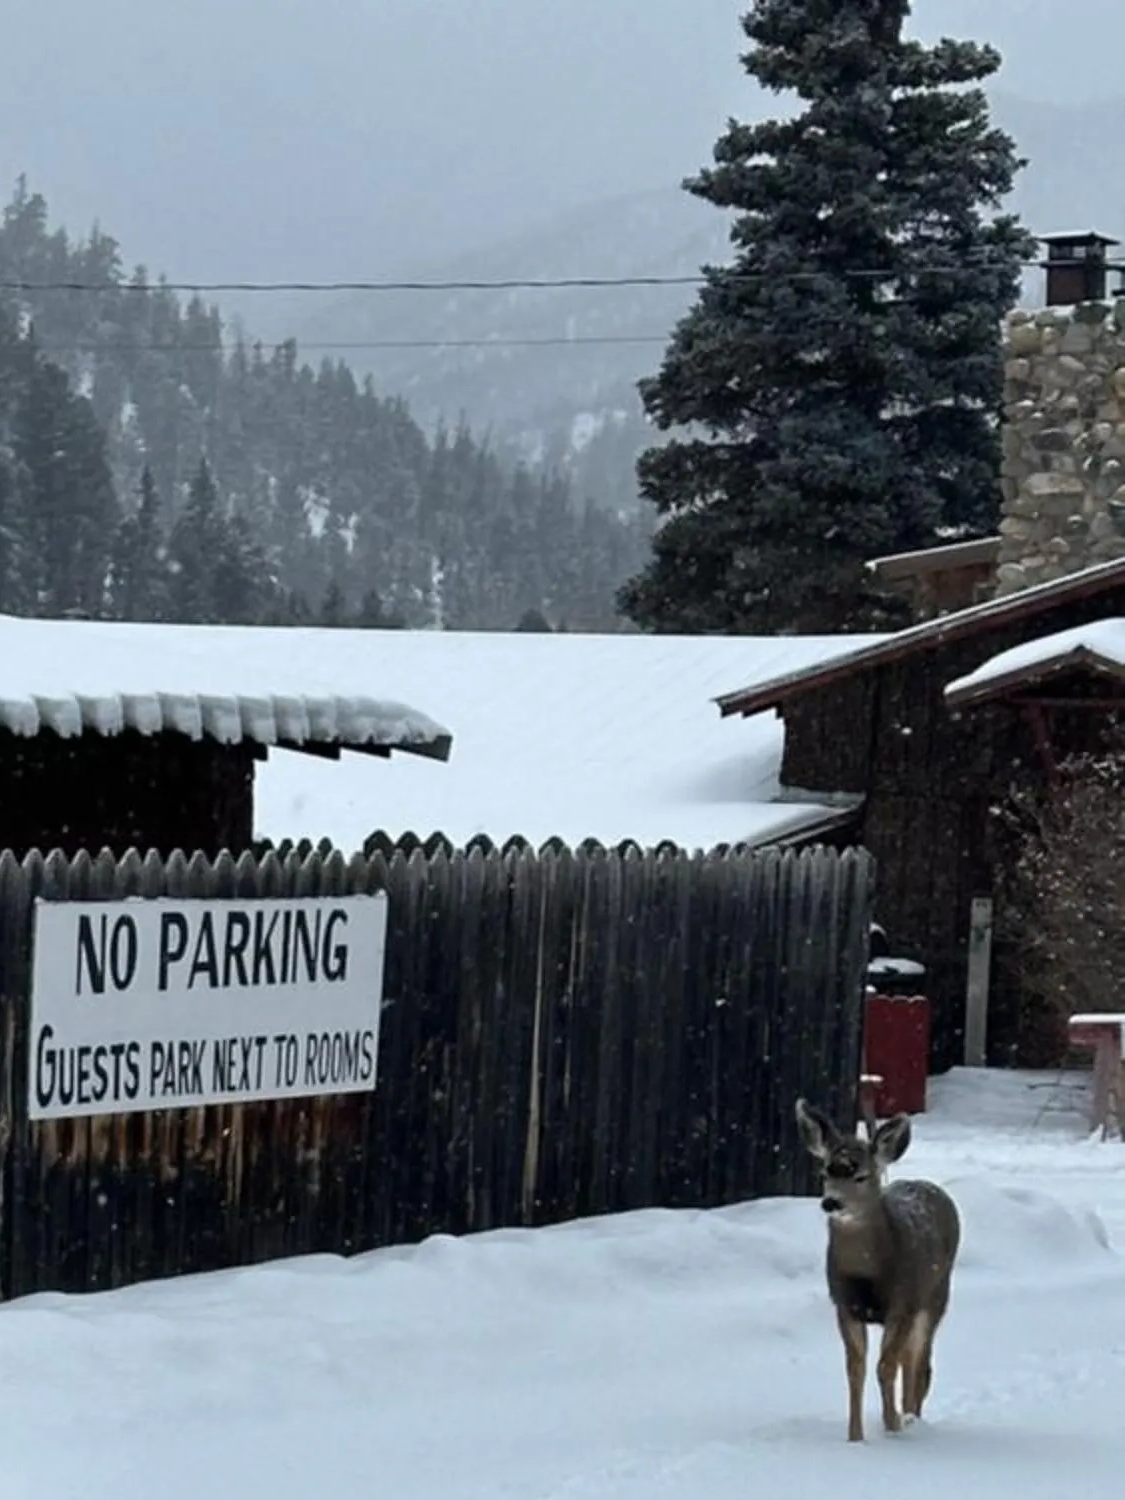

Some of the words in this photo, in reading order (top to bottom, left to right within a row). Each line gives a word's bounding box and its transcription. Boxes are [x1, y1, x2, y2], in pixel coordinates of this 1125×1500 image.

[76, 913, 138, 996] NO
[158, 909, 349, 991] PARKING
[36, 1024, 140, 1108] GUESTS
[149, 1039, 207, 1098] PARK
[212, 1035, 267, 1093] NEXT
[274, 1034, 298, 1087] TO
[304, 1029, 374, 1085] ROOMS
